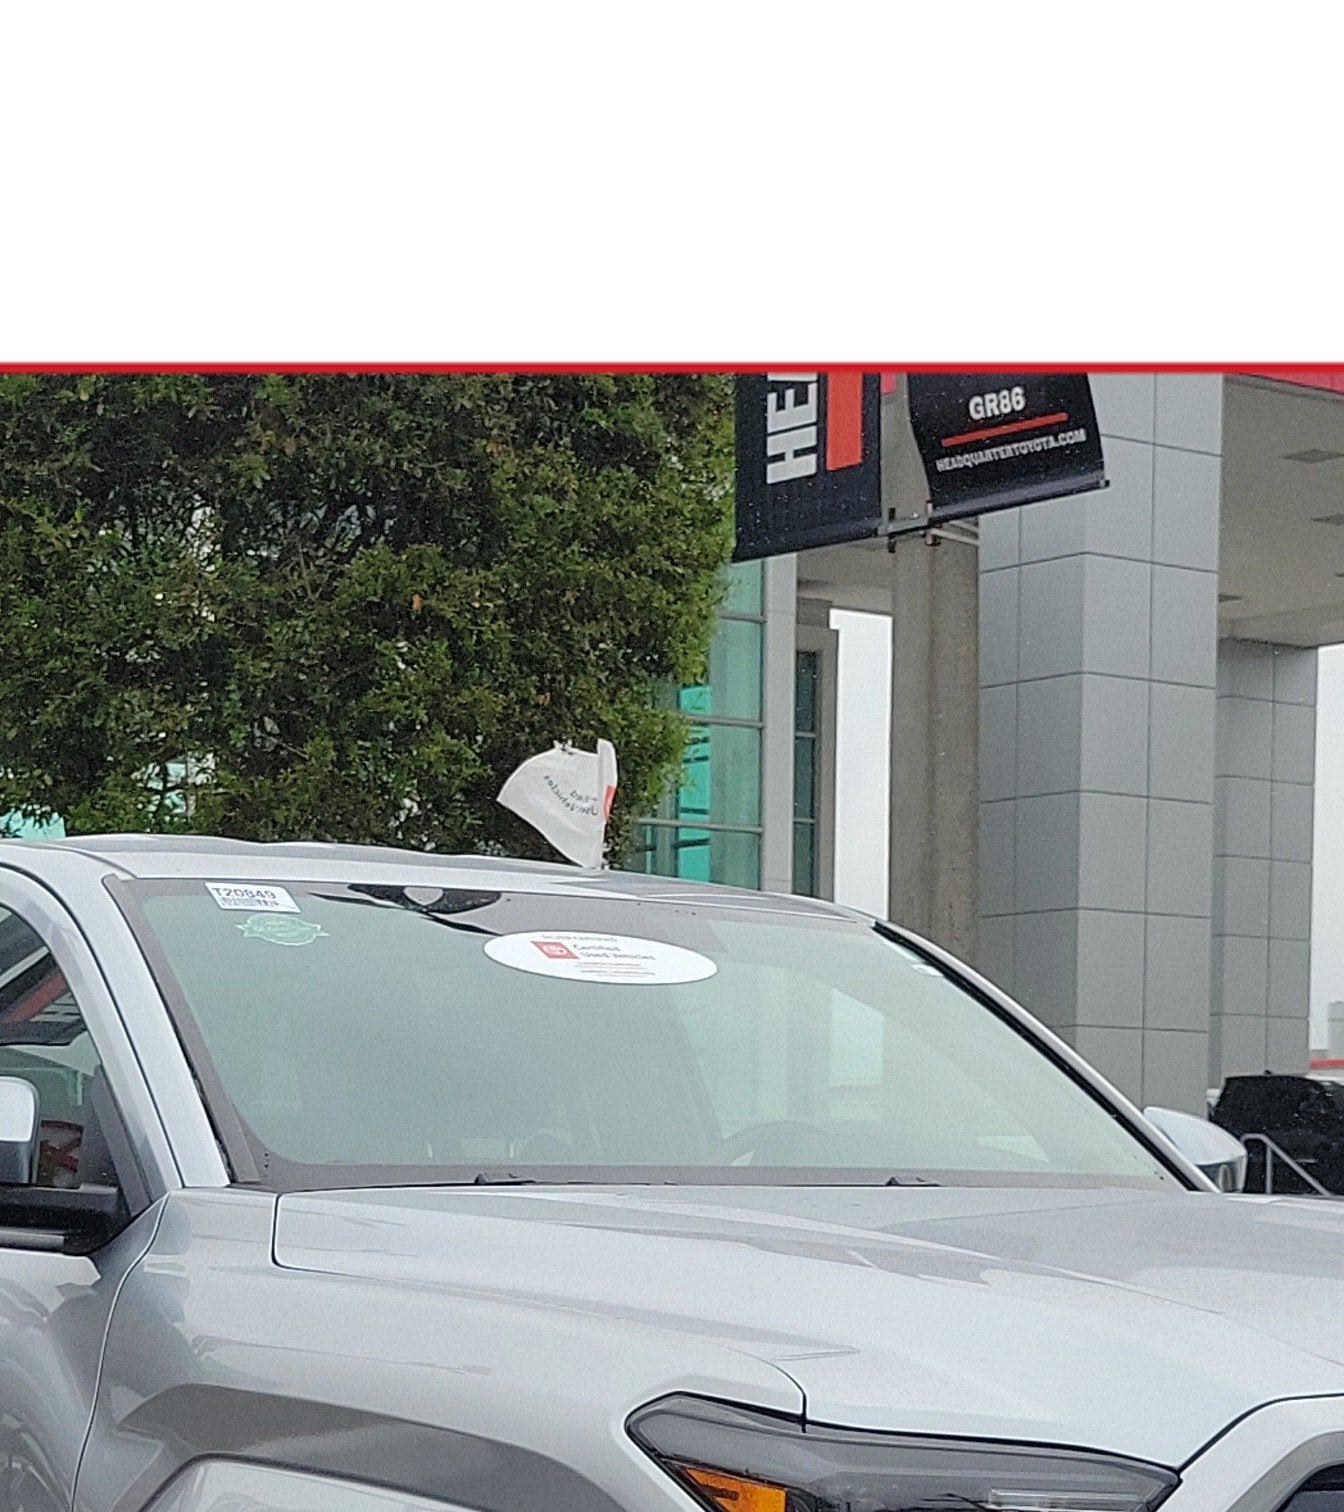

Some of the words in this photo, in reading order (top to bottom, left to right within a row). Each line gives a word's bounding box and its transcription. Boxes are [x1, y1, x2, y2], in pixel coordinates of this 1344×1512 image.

[968, 385, 1026, 421] GR86
[766, 373, 818, 485] HE
[935, 428, 1087, 473] HEADQUARTERTOYOTA.COM
